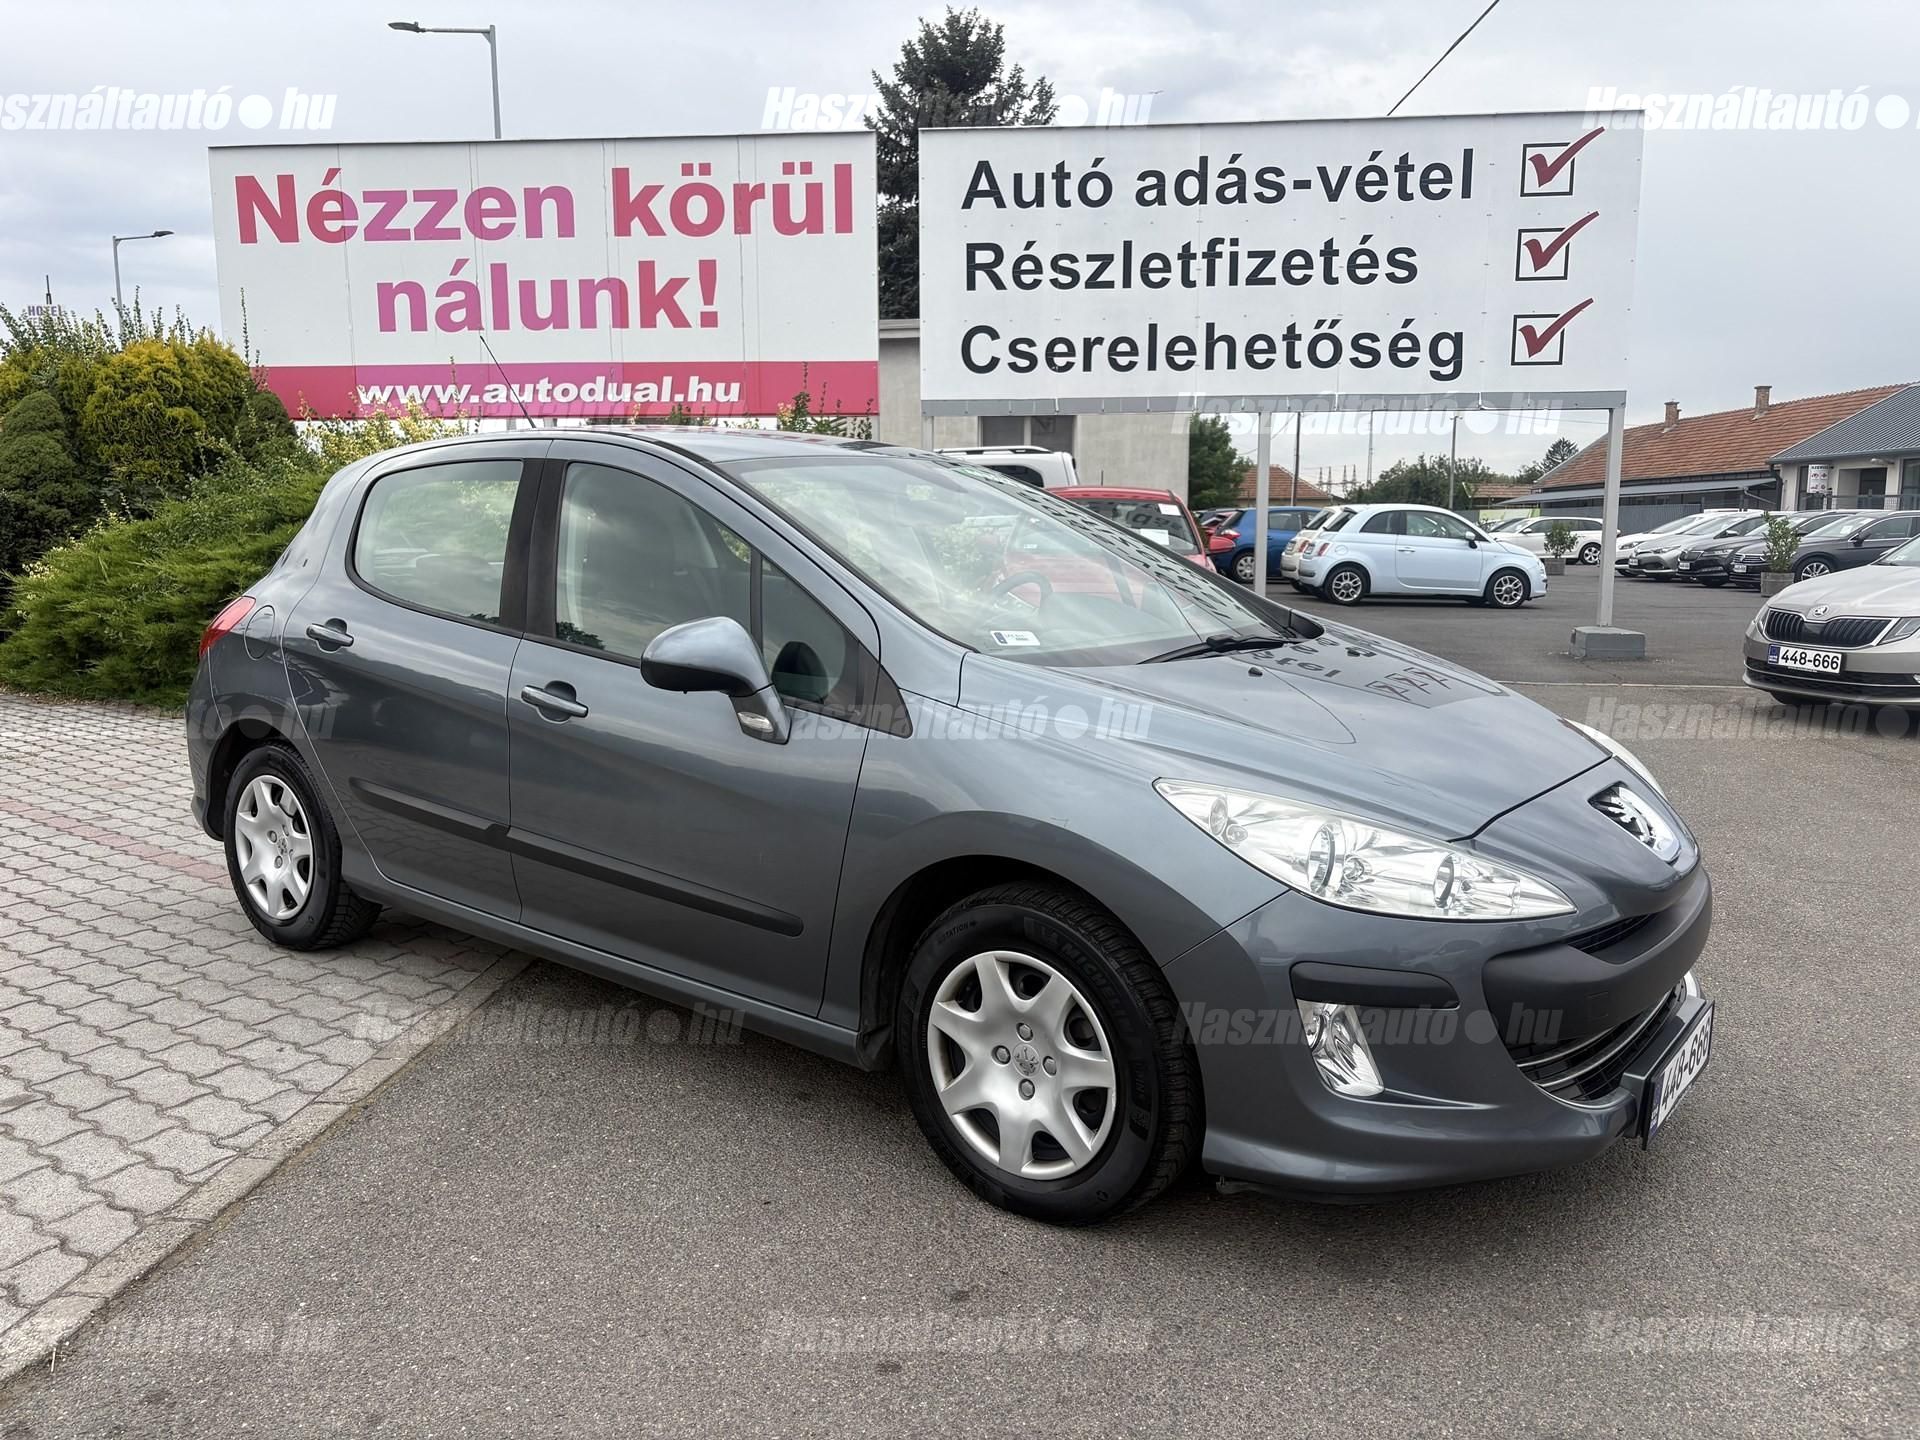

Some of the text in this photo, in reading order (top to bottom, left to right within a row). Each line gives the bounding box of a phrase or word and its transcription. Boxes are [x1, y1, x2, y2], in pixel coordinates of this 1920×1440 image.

[234, 161, 854, 244] Nézzen körül
[962, 148, 1474, 210] Autó adás-vétel
[964, 235, 1418, 291] Részletfizetés
[28, 305, 61, 317] HOE
[376, 259, 718, 333] nálunk!
[961, 319, 1464, 381] Cserelehetőség
[357, 375, 741, 406] www.autodual.hu
[1781, 649, 1840, 670] 448-666
[1661, 1015, 1712, 1110] 448-666
